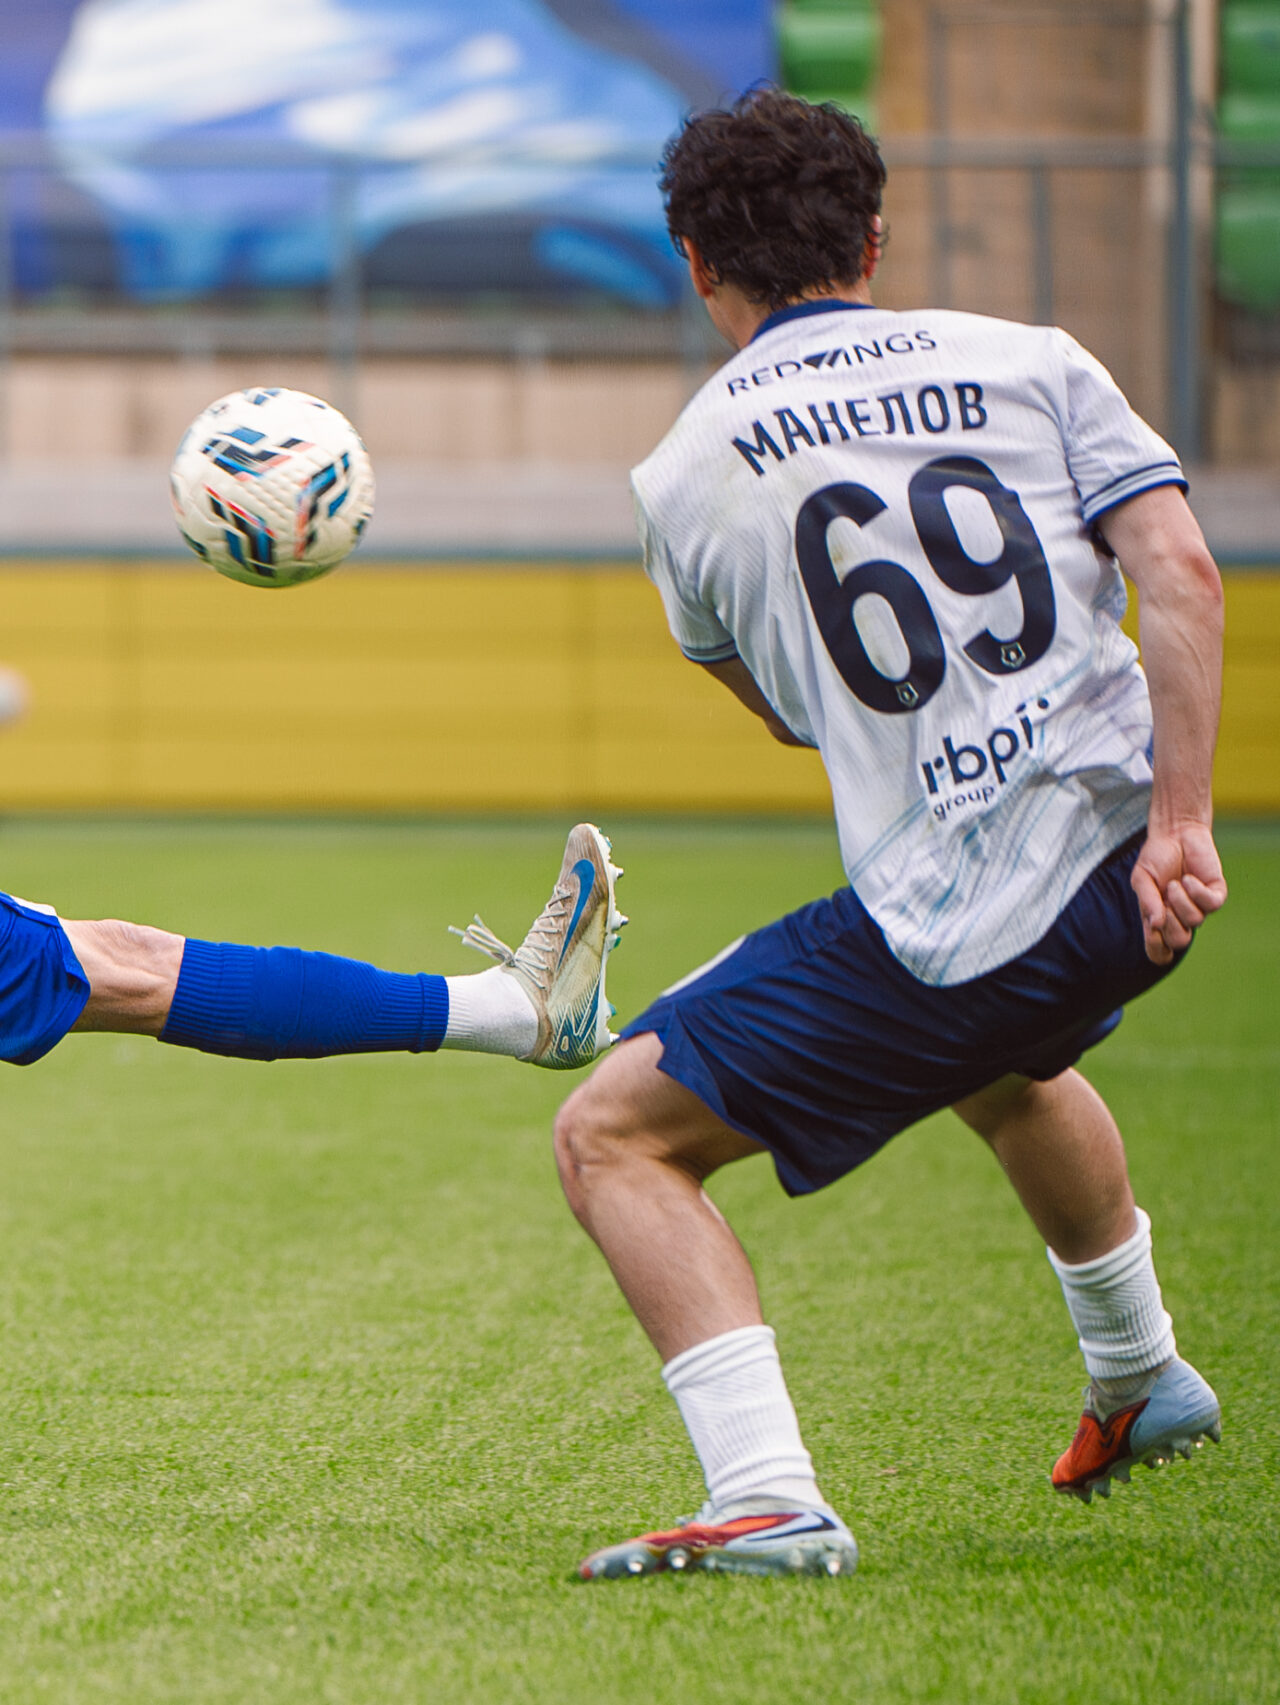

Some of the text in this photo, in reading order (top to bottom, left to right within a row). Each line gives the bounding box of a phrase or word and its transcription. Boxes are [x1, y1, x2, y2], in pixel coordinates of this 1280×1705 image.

[731, 382, 987, 477] МАНЕЛОВ
[795, 454, 1057, 715] 69
[933, 785, 995, 822] group
